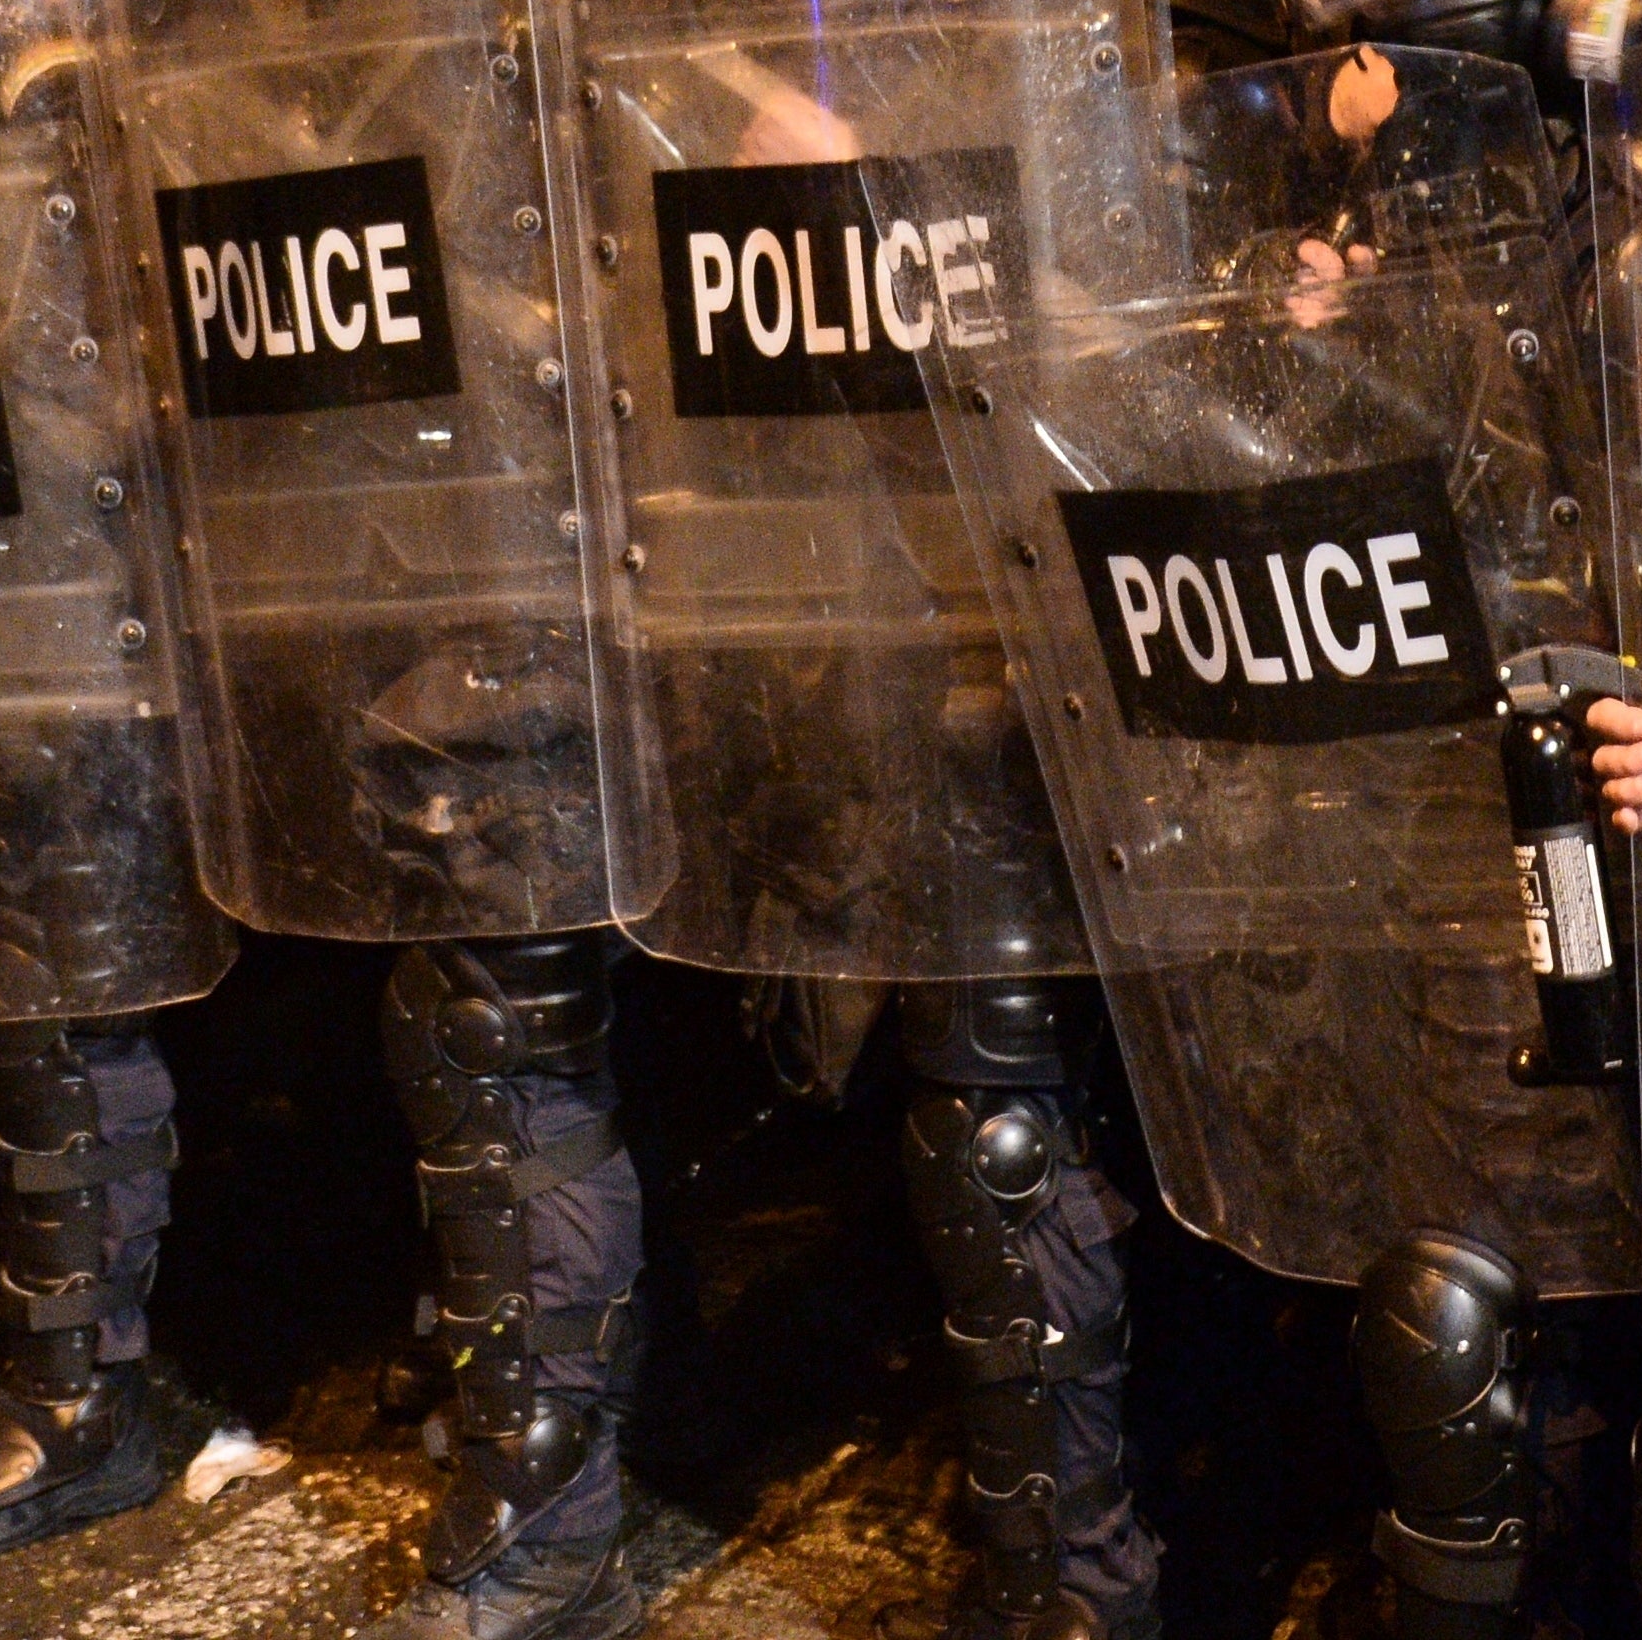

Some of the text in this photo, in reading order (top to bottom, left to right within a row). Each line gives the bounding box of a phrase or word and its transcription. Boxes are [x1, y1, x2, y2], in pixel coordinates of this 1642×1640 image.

[183, 222, 422, 360] POLICE
[689, 215, 1009, 358] POLICE
[1107, 532, 1450, 684] POLICE
